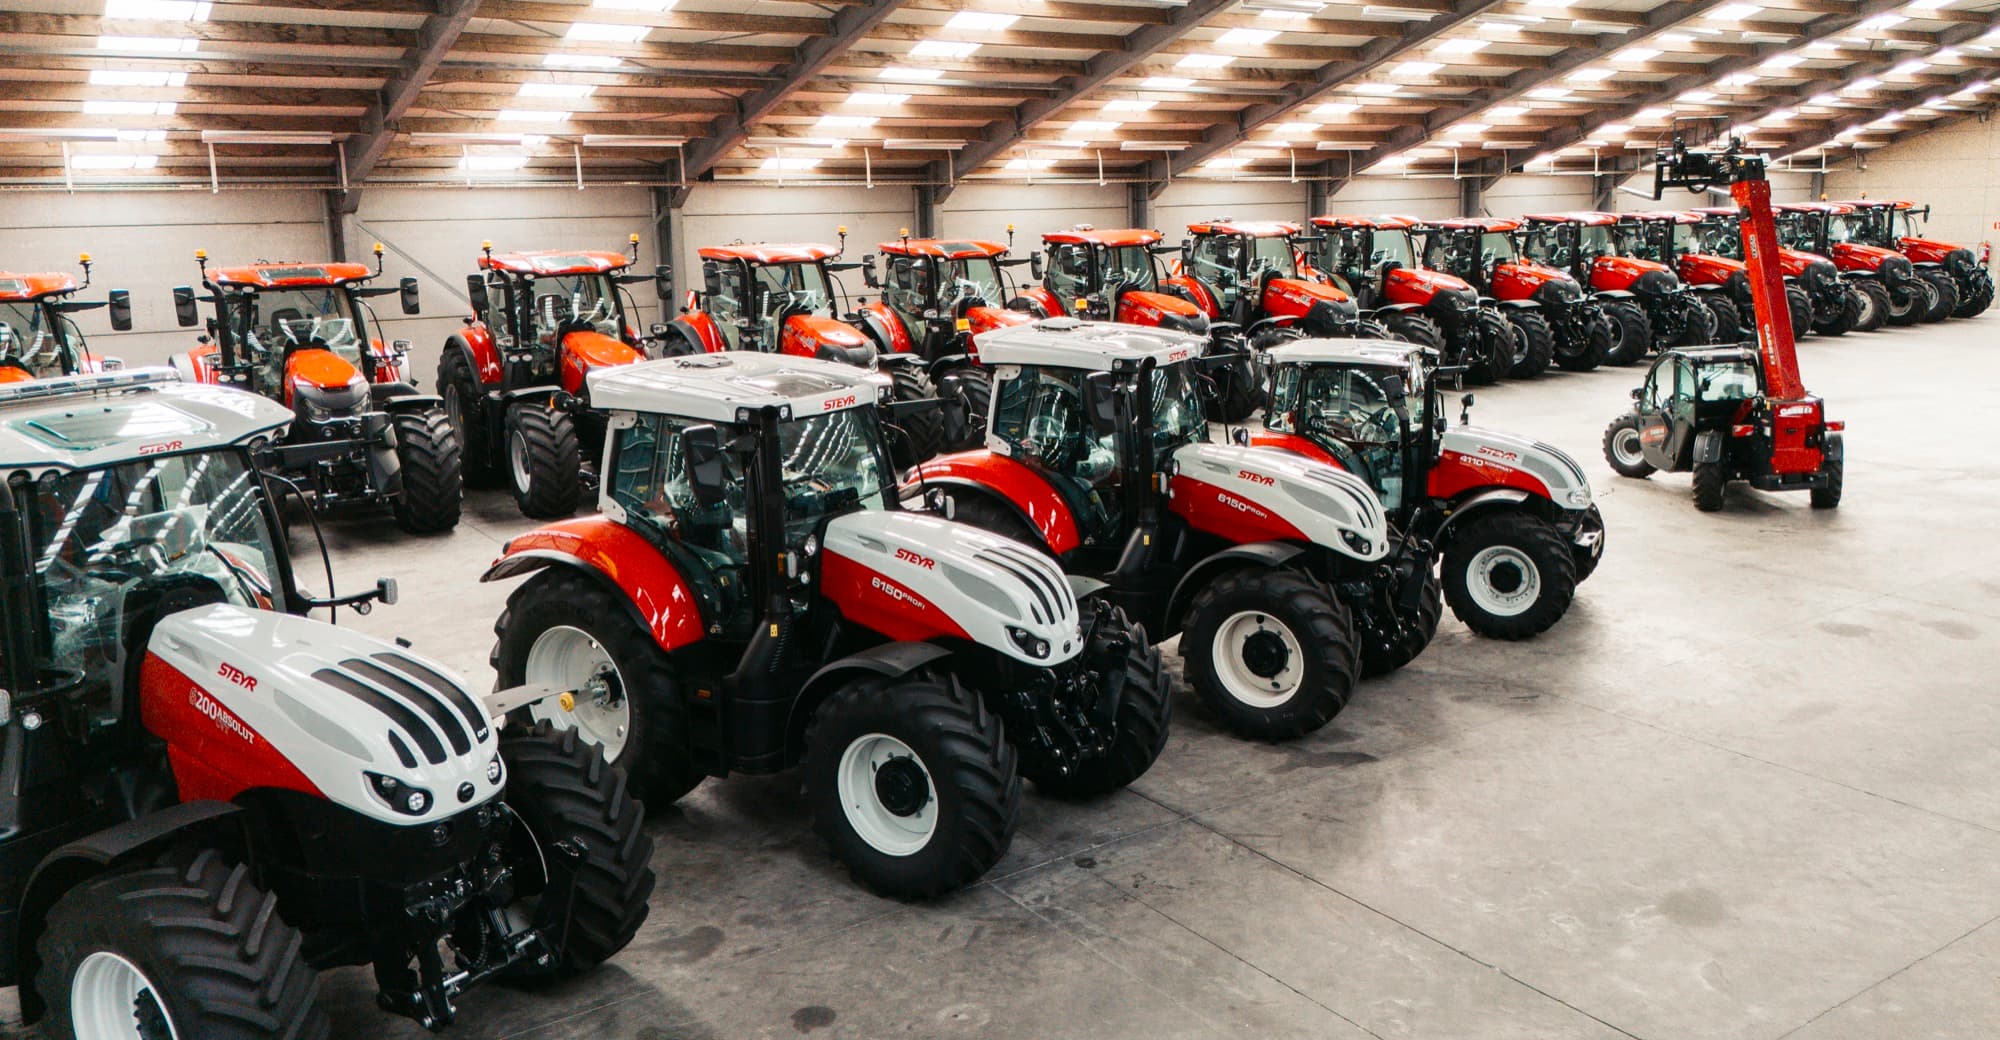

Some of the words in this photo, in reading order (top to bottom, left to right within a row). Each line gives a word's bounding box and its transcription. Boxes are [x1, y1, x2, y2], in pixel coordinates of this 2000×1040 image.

[1168, 350, 1188, 362] STEYR
[823, 395, 856, 411] STEYR
[138, 440, 183, 455] STEYR
[1478, 445, 1518, 461] STEYR
[1460, 455, 1484, 467] 4110
[1237, 469, 1275, 487] STEYR
[1217, 492, 1247, 513] 6150
[894, 548, 935, 571] STEYR
[871, 576, 903, 601] 6150
[902, 592, 926, 611] PROFI
[216, 661, 258, 692] STEYR
[216, 706, 255, 745] ABSOLUT
